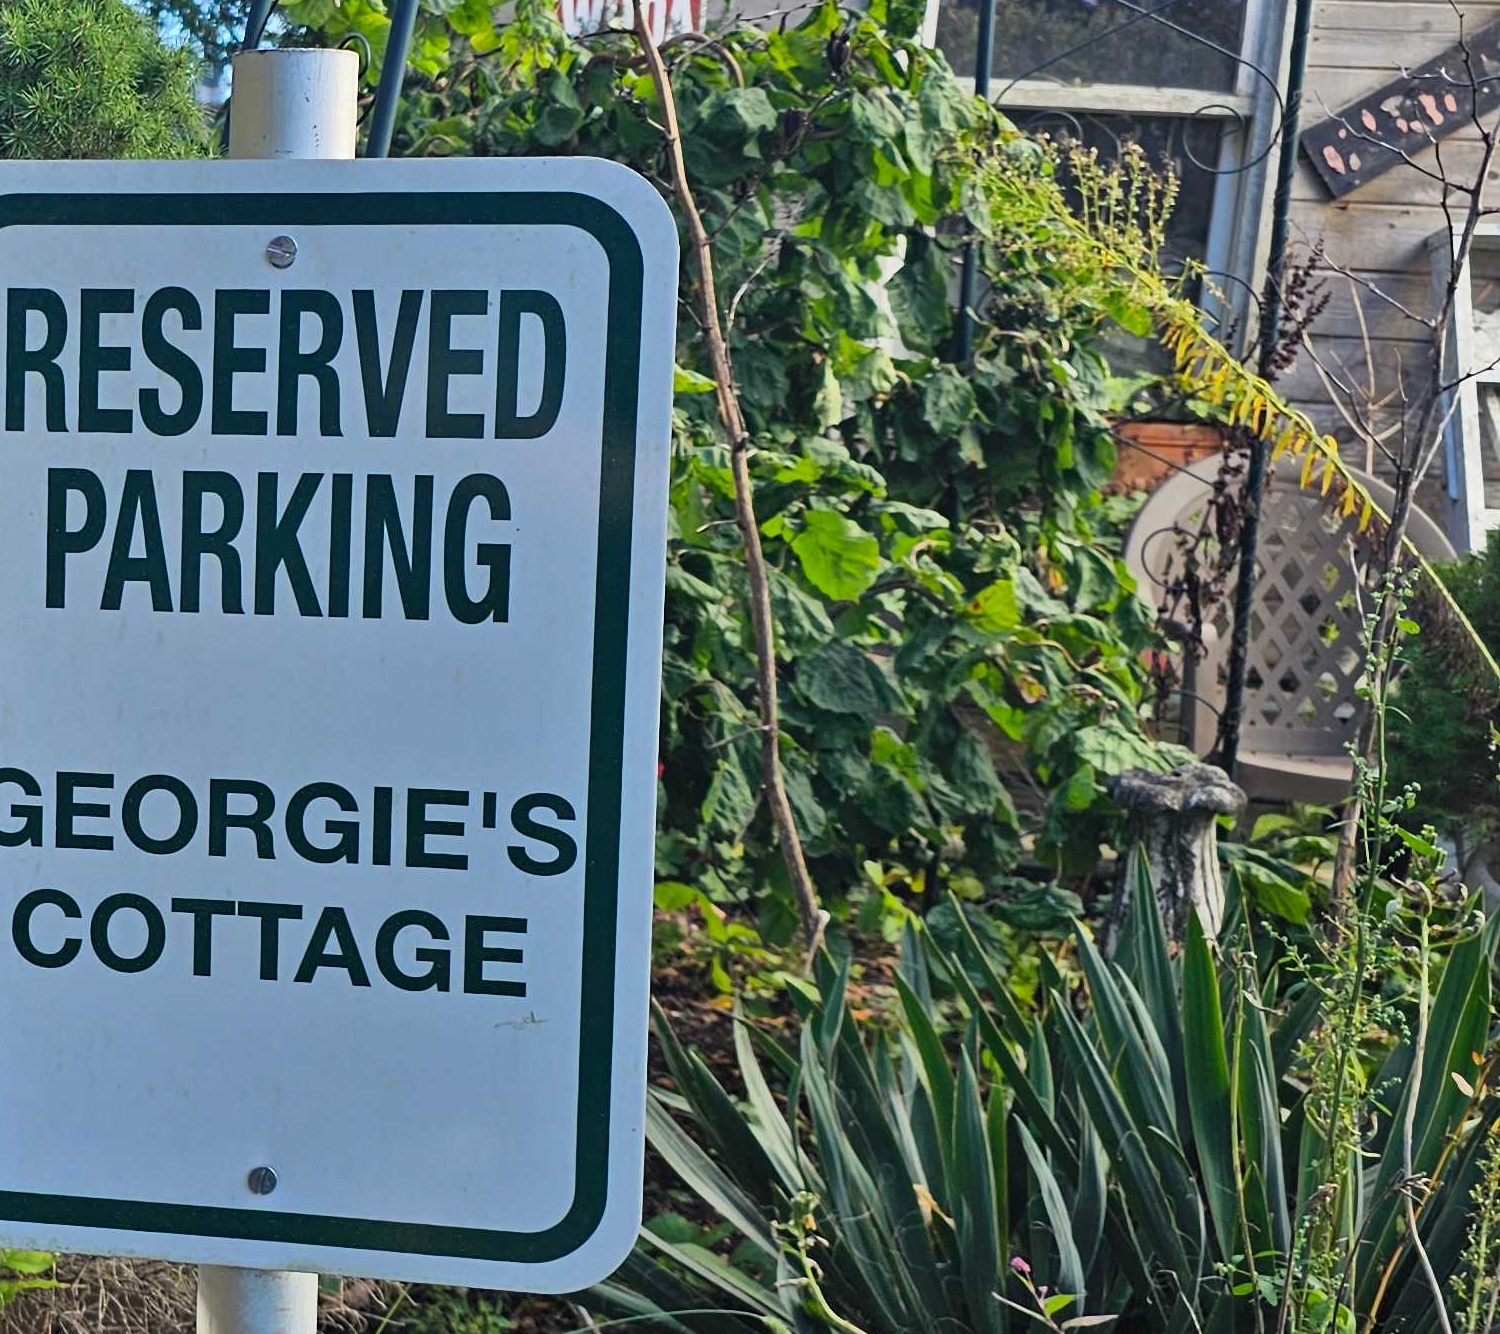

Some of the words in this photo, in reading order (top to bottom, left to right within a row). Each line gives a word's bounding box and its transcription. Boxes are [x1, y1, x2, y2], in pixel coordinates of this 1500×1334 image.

[4, 287, 567, 440] RESERVED
[45, 467, 512, 625] PARKING
[11, 888, 528, 998] COTTAGE
